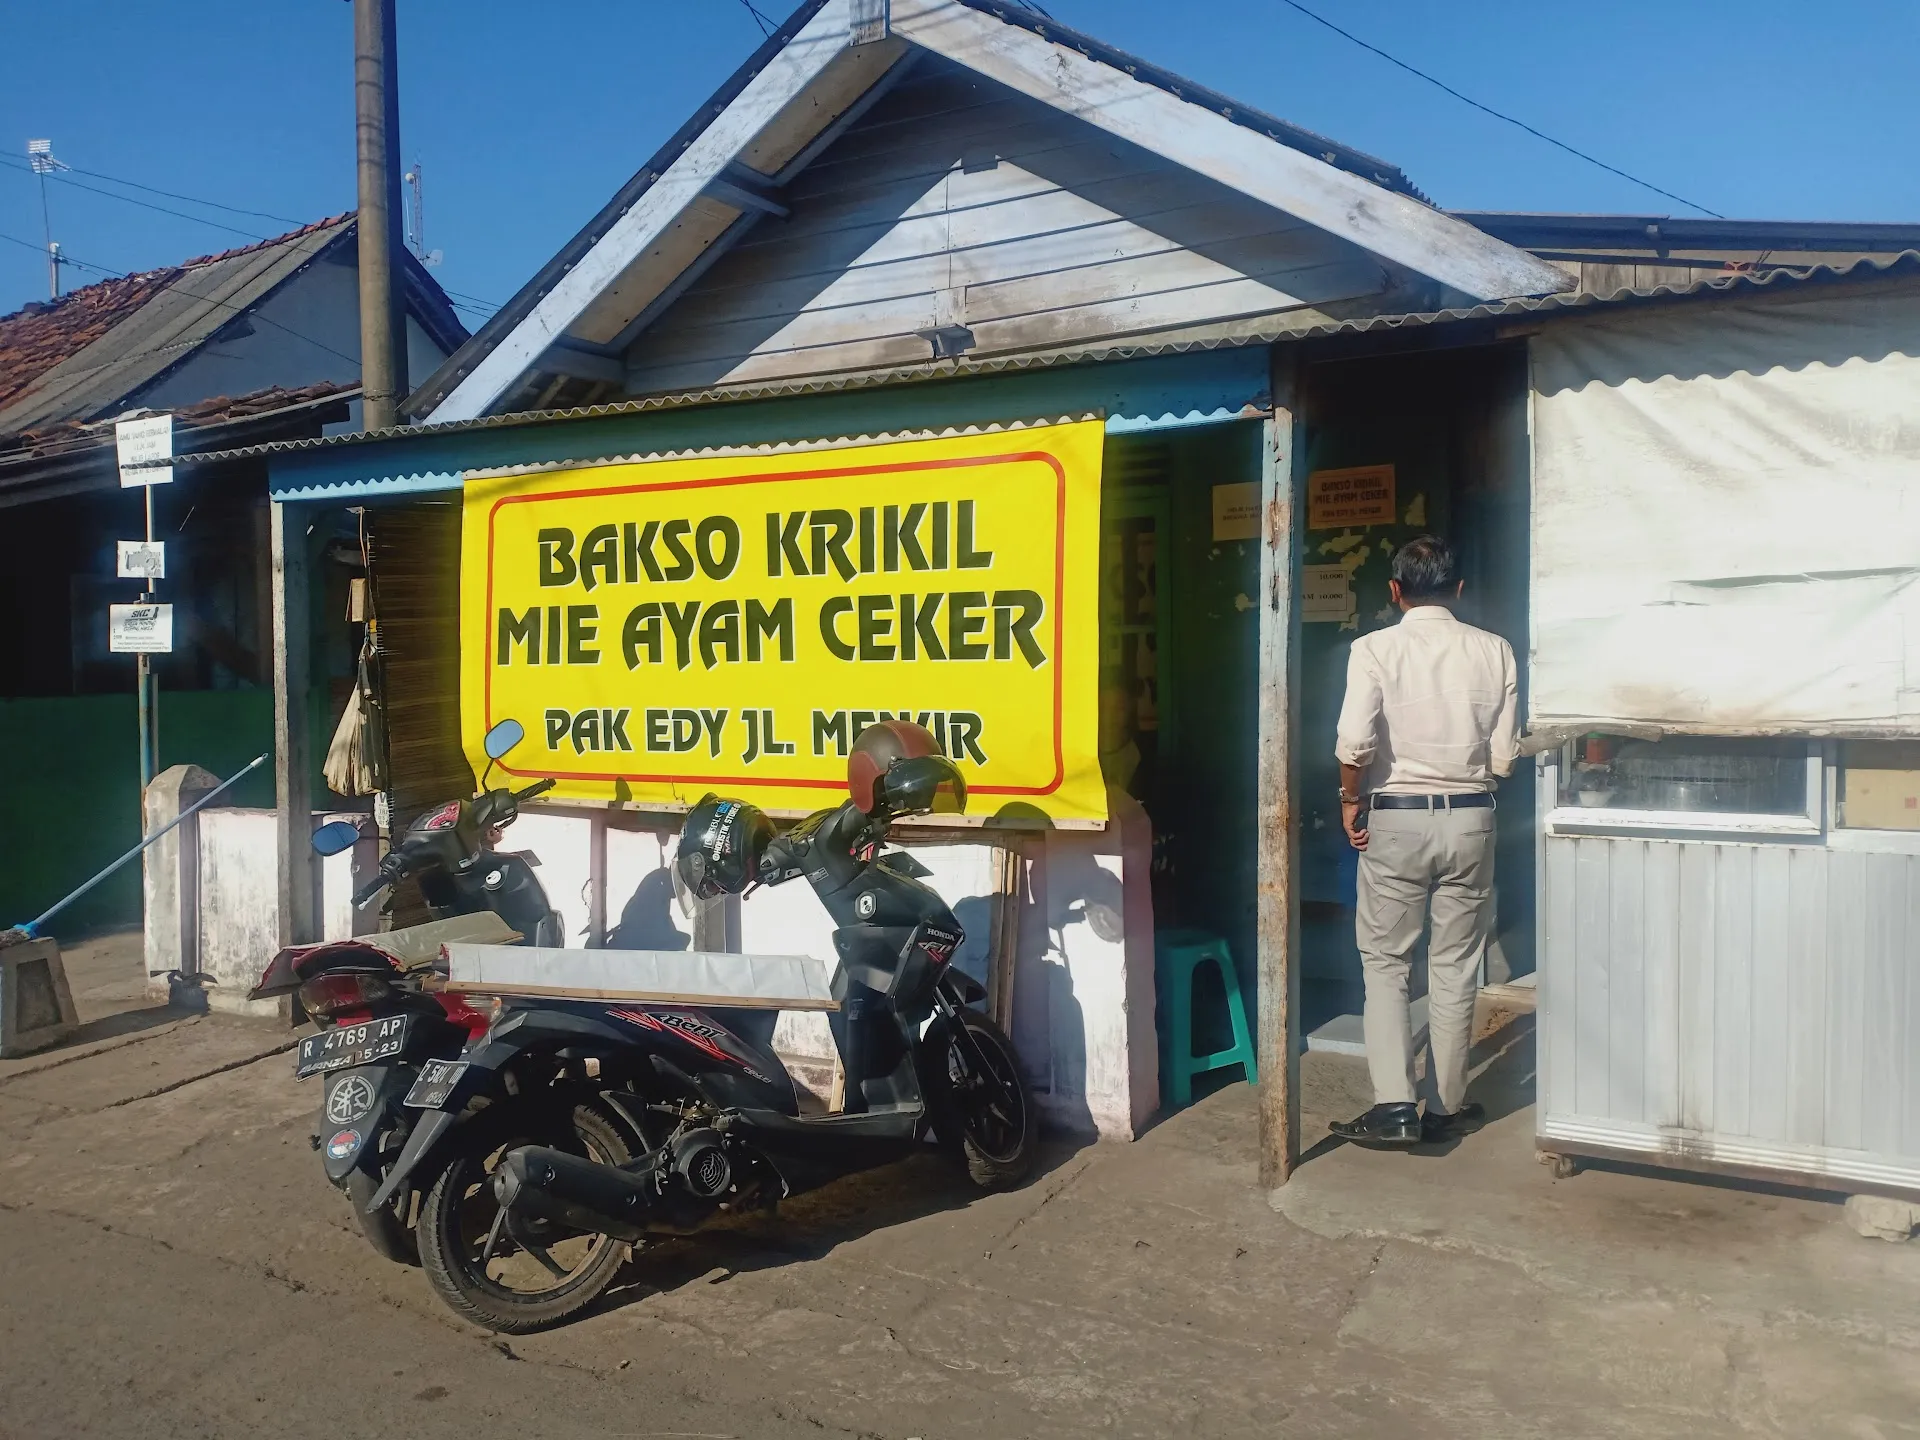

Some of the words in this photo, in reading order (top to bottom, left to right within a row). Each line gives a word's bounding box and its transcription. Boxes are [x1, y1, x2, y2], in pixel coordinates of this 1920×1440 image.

[1315, 494, 1332, 505] MIE
[1333, 491, 1358, 504] AYAM
[1321, 479, 1351, 491] BAKSO
[538, 515, 740, 592] BAKSO
[766, 499, 994, 583] KRIKIL
[497, 604, 600, 665] MIE
[622, 598, 794, 671] AYAM
[819, 590, 1047, 670] CEKER
[546, 709, 631, 756] PAK
[646, 709, 728, 759] EDY
[741, 709, 795, 765] JL.
[812, 710, 988, 767] MIR
[927, 928, 956, 941] HONDA
[304, 1040, 313, 1058] R
[324, 1027, 367, 1050] 4769
[379, 1019, 401, 1038] AP
